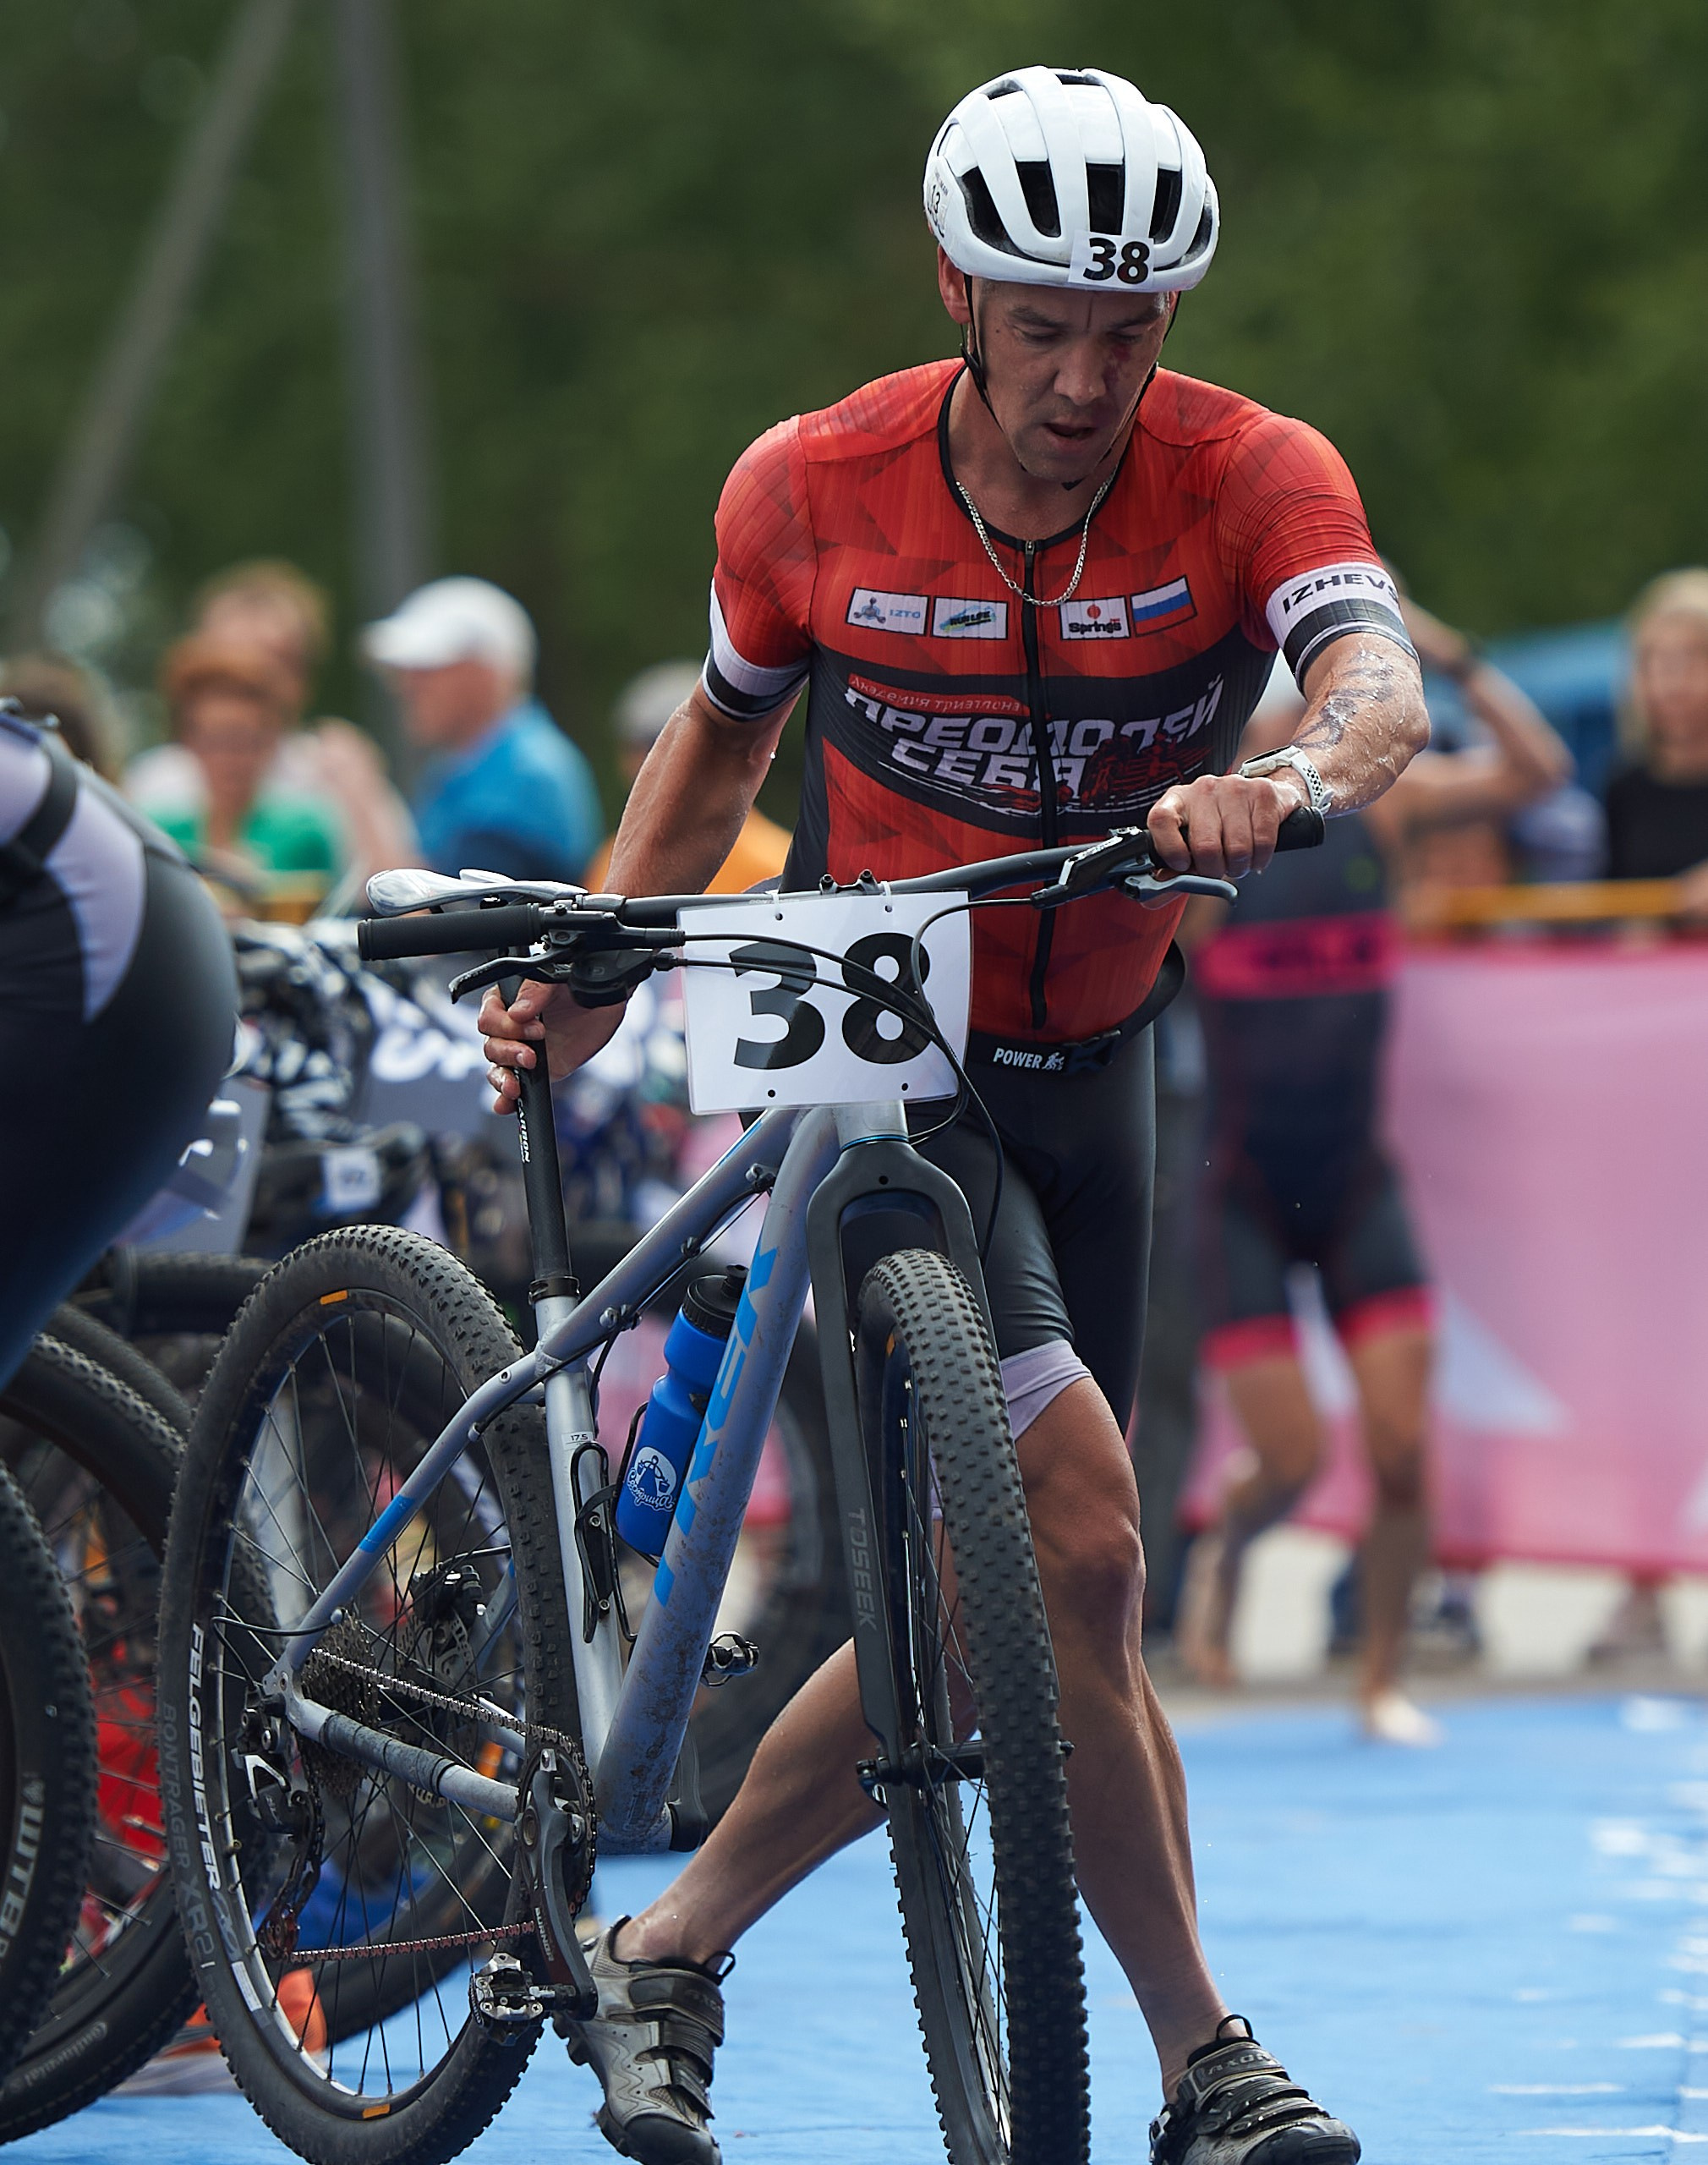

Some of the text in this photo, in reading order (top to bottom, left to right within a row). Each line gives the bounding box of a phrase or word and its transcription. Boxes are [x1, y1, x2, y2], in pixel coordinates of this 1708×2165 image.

[1083, 237, 1151, 285] 38
[890, 609, 921, 619] IZTO
[1068, 620, 1122, 635] Springs
[851, 677, 1021, 713] Академия триатлона
[728, 931, 931, 1072] 38
[993, 1047, 1043, 1070] POWER
[517, 1098, 530, 1163] CARBON
[848, 1507, 877, 1631] TOSEEK
[163, 1702, 191, 1869] BONTRAGER
[189, 1622, 222, 1891] FELGEBIETER
[0, 1804, 42, 1936] WTB
